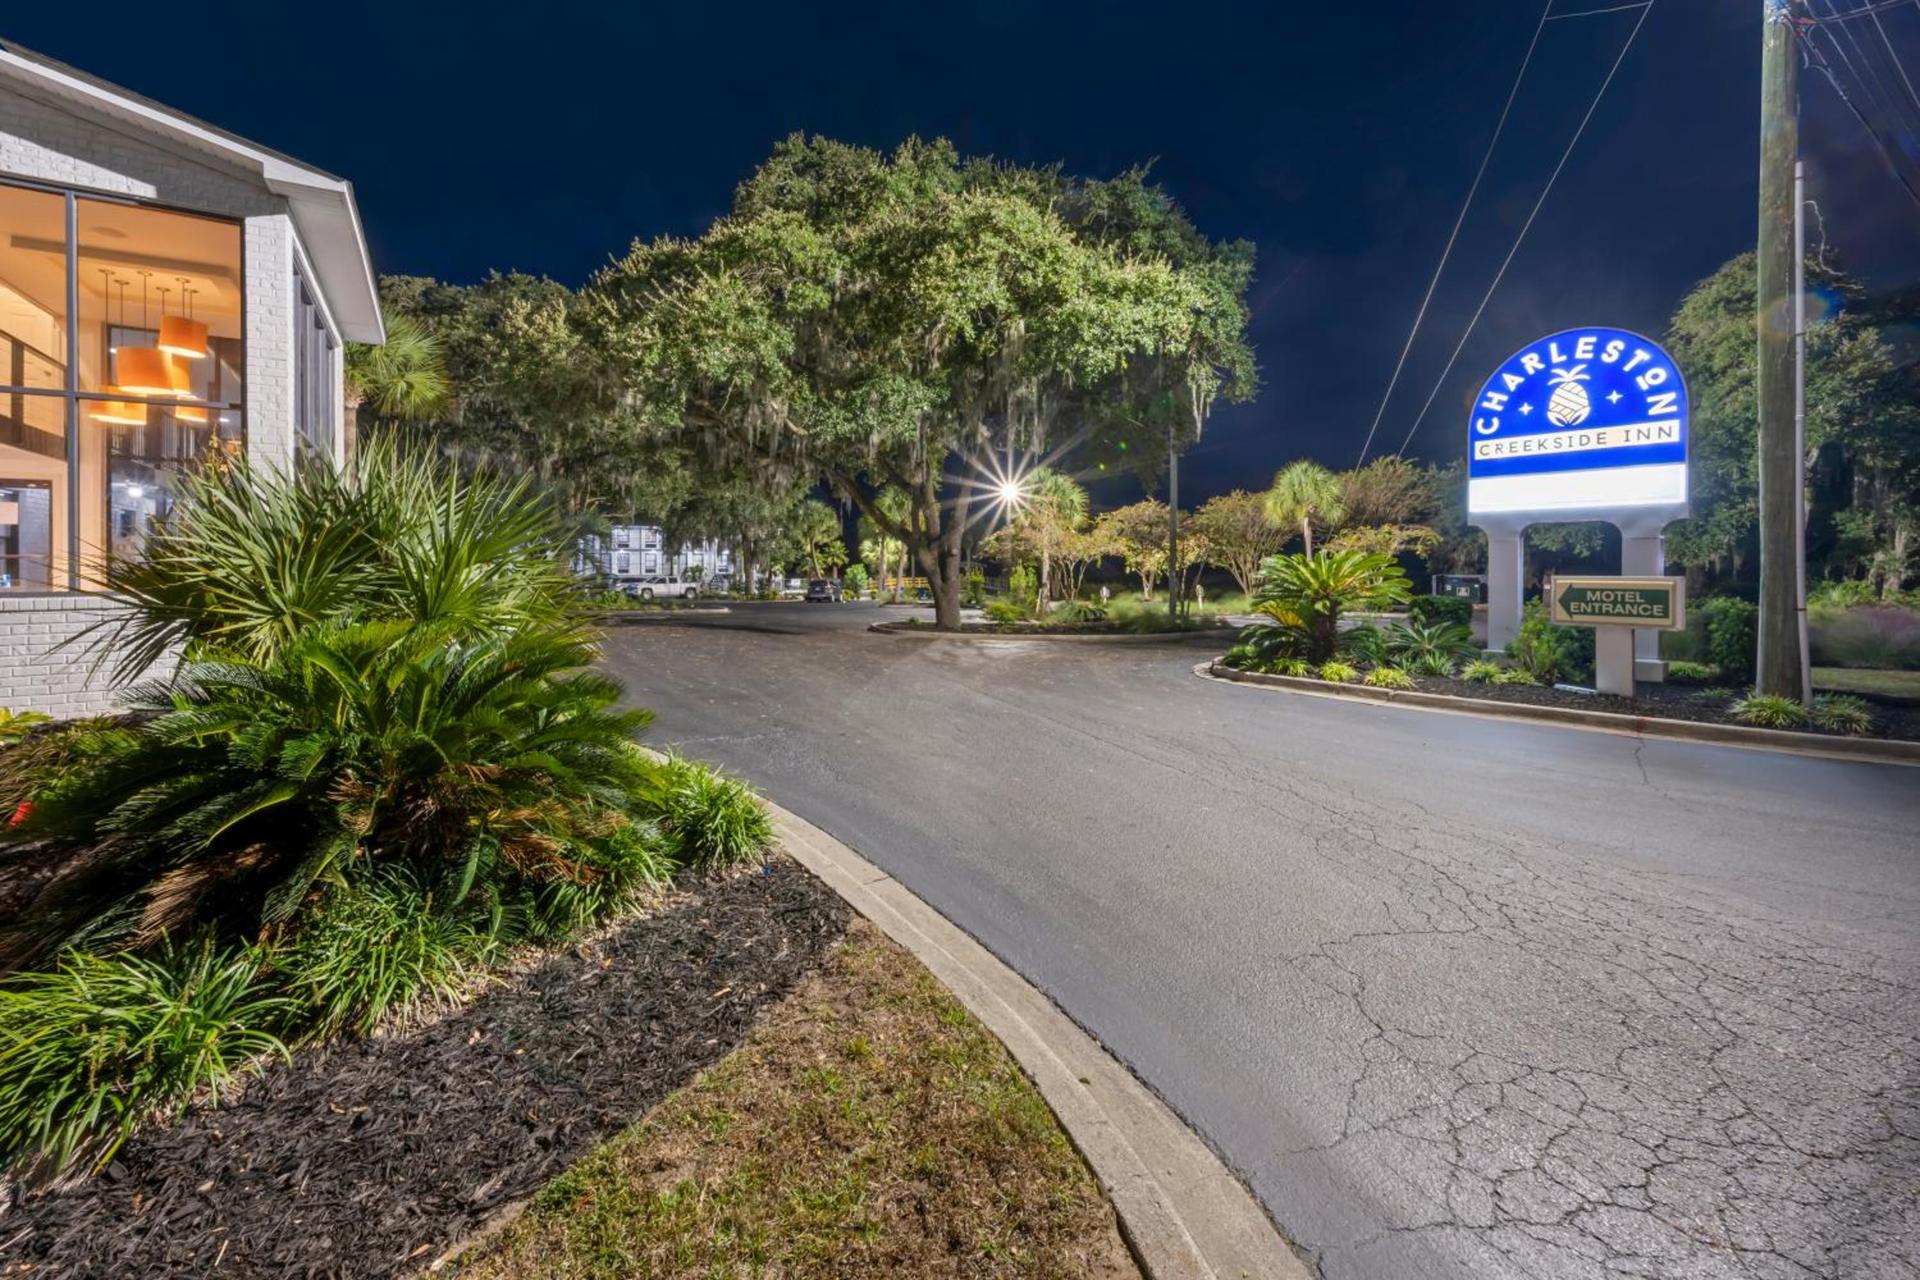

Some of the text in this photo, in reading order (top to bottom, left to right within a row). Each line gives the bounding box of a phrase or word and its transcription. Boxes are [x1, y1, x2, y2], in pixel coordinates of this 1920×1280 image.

[1476, 336, 1678, 435] CHARLESTON
[1479, 425, 1674, 456] CREEKSIDE INN
[1586, 590, 1645, 603] MOTEL
[1570, 602, 1664, 616] ENTRANCE
